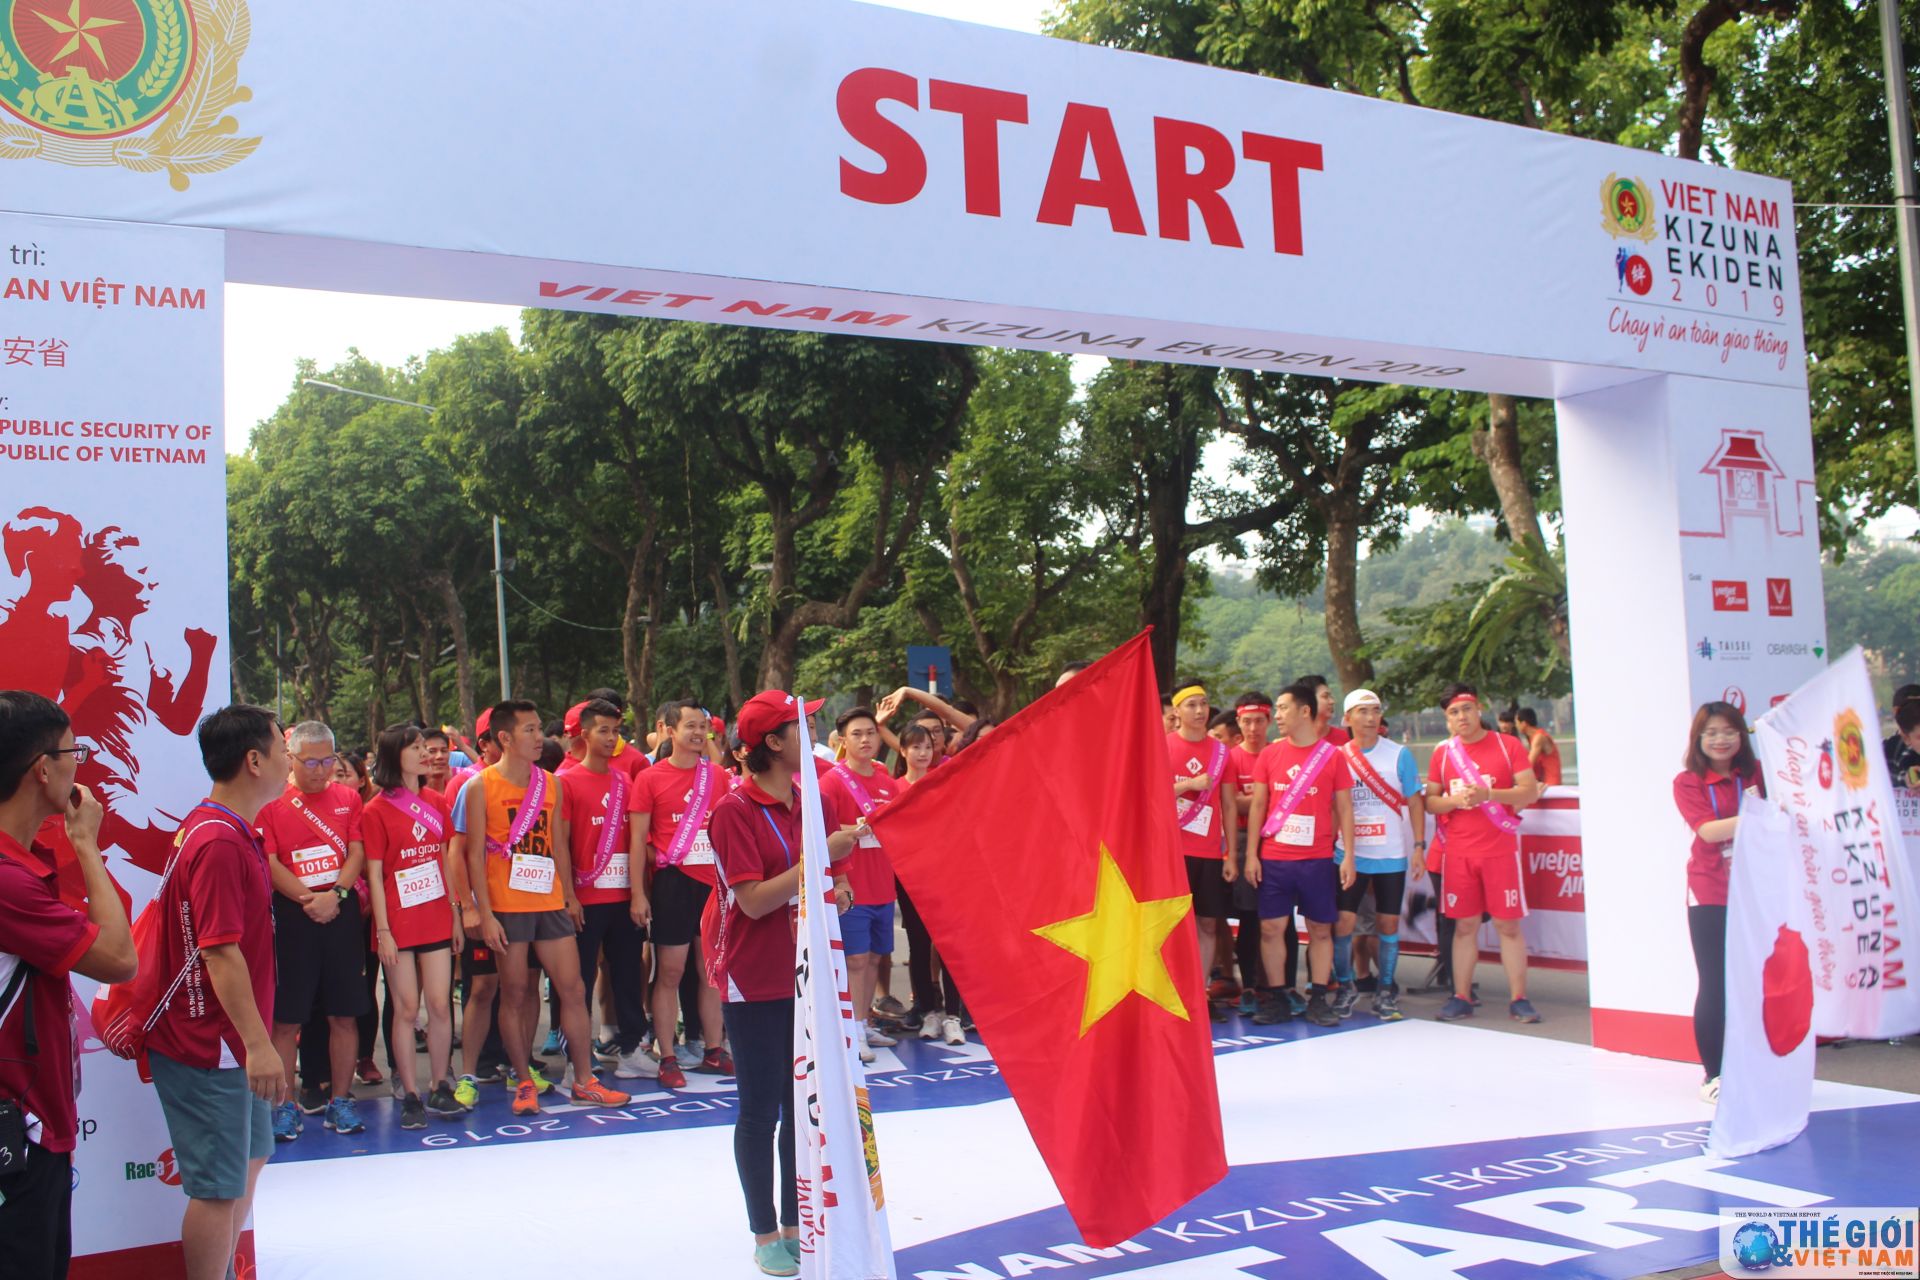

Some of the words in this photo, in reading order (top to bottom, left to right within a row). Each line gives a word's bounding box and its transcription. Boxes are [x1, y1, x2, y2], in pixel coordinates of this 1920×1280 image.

[836, 67, 1324, 257] START
[1661, 178, 1717, 216] VIET
[1725, 192, 1779, 229] NAM
[1665, 213, 1781, 260] KIZUNA
[10, 242, 46, 267] trì:
[1667, 247, 1783, 291] EKIDEN
[3, 277, 50, 301] AN
[60, 276, 126, 310] VIỆT
[135, 285, 206, 310] NAM
[1672, 278, 1784, 317] 2019
[538, 280, 713, 310] VIET
[721, 298, 912, 330] NAM
[916, 317, 1148, 352] KIZUNA
[1163, 339, 1359, 371] EKIDEN
[1347, 359, 1467, 379] 2019
[1608, 306, 1650, 352] Chạy
[1653, 315, 1666, 338] vì
[1668, 324, 1687, 342] an
[1690, 320, 1719, 345] toàn
[1721, 328, 1750, 364] giao
[1753, 328, 1789, 371] thông
[0, 418, 74, 437] PUBLIC
[80, 420, 180, 440] SECURITY
[185, 424, 212, 441] OF
[76, 445, 104, 463] OF
[110, 447, 206, 464] VIETNAM
[1719, 640, 1752, 652] TAISEI
[303, 807, 334, 838] VIETNAM
[517, 808, 535, 837] KIZUNA
[529, 780, 544, 808] EKIDEN
[688, 795, 703, 823] KIZUNA
[1280, 824, 1311, 835] 030-1
[299, 856, 340, 875] 1016-1
[515, 867, 552, 882] 2007-1
[403, 874, 441, 895] 2022-1
[1504, 888, 1518, 908] 18
[1833, 810, 1869, 990] EKIDEN
[1849, 806, 1881, 990] KIZUNA
[1866, 800, 1892, 889] VIET
[1882, 902, 1907, 990] NAM
[422, 1118, 570, 1147] 2019
[1152, 1184, 1434, 1244] KIZUNA
[1418, 1143, 1648, 1192] EKIDEN
